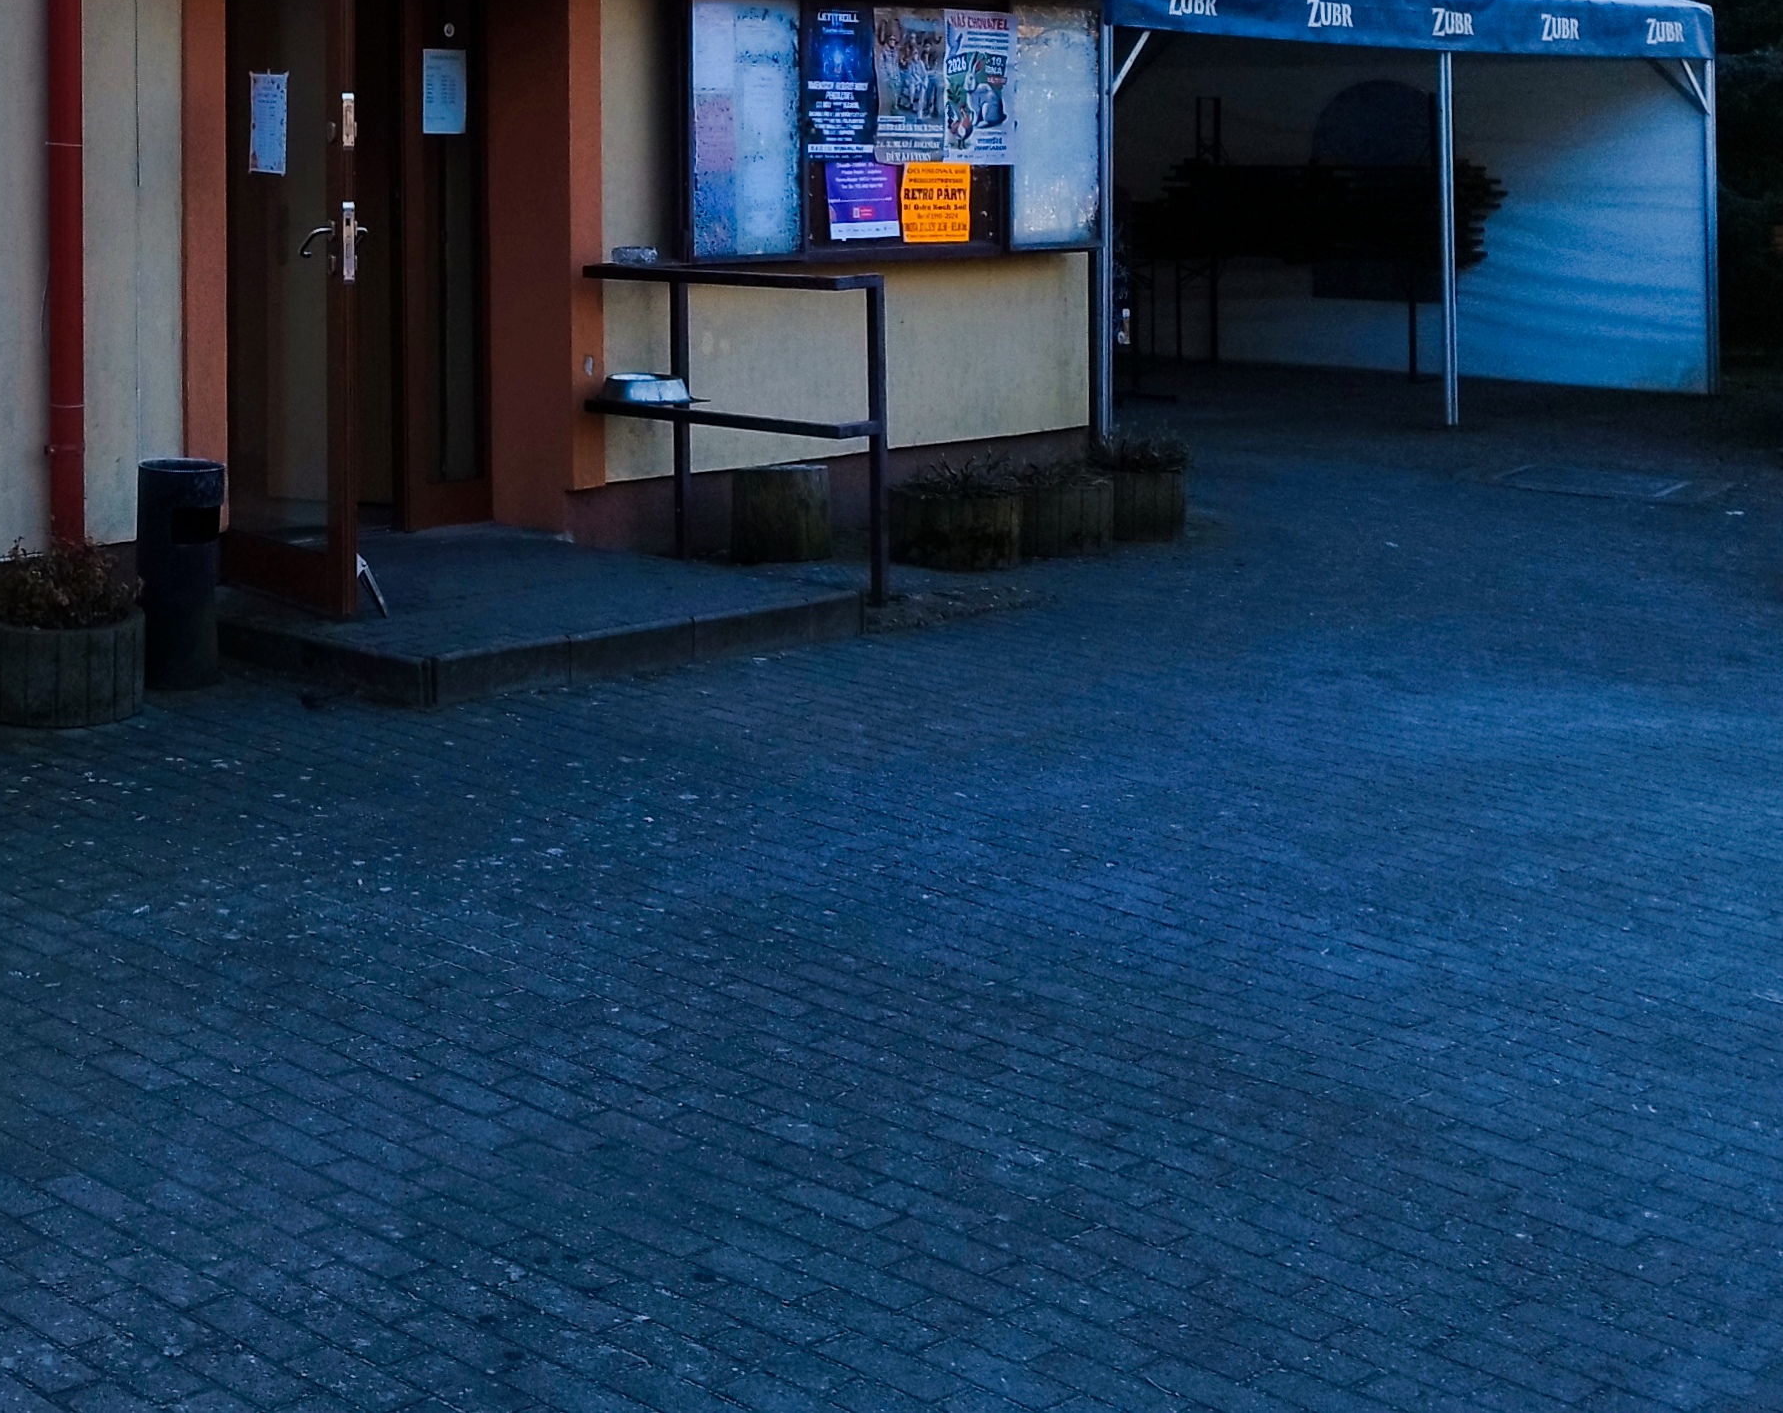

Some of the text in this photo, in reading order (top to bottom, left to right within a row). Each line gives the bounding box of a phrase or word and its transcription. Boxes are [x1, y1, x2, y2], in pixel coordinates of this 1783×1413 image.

[1432, 7, 1474, 36] ZUBR
[1541, 14, 1579, 41] ZUBR
[1646, 18, 1684, 45] ZUBR
[947, 56, 967, 74] 2026
[903, 187, 934, 201] RETRO
